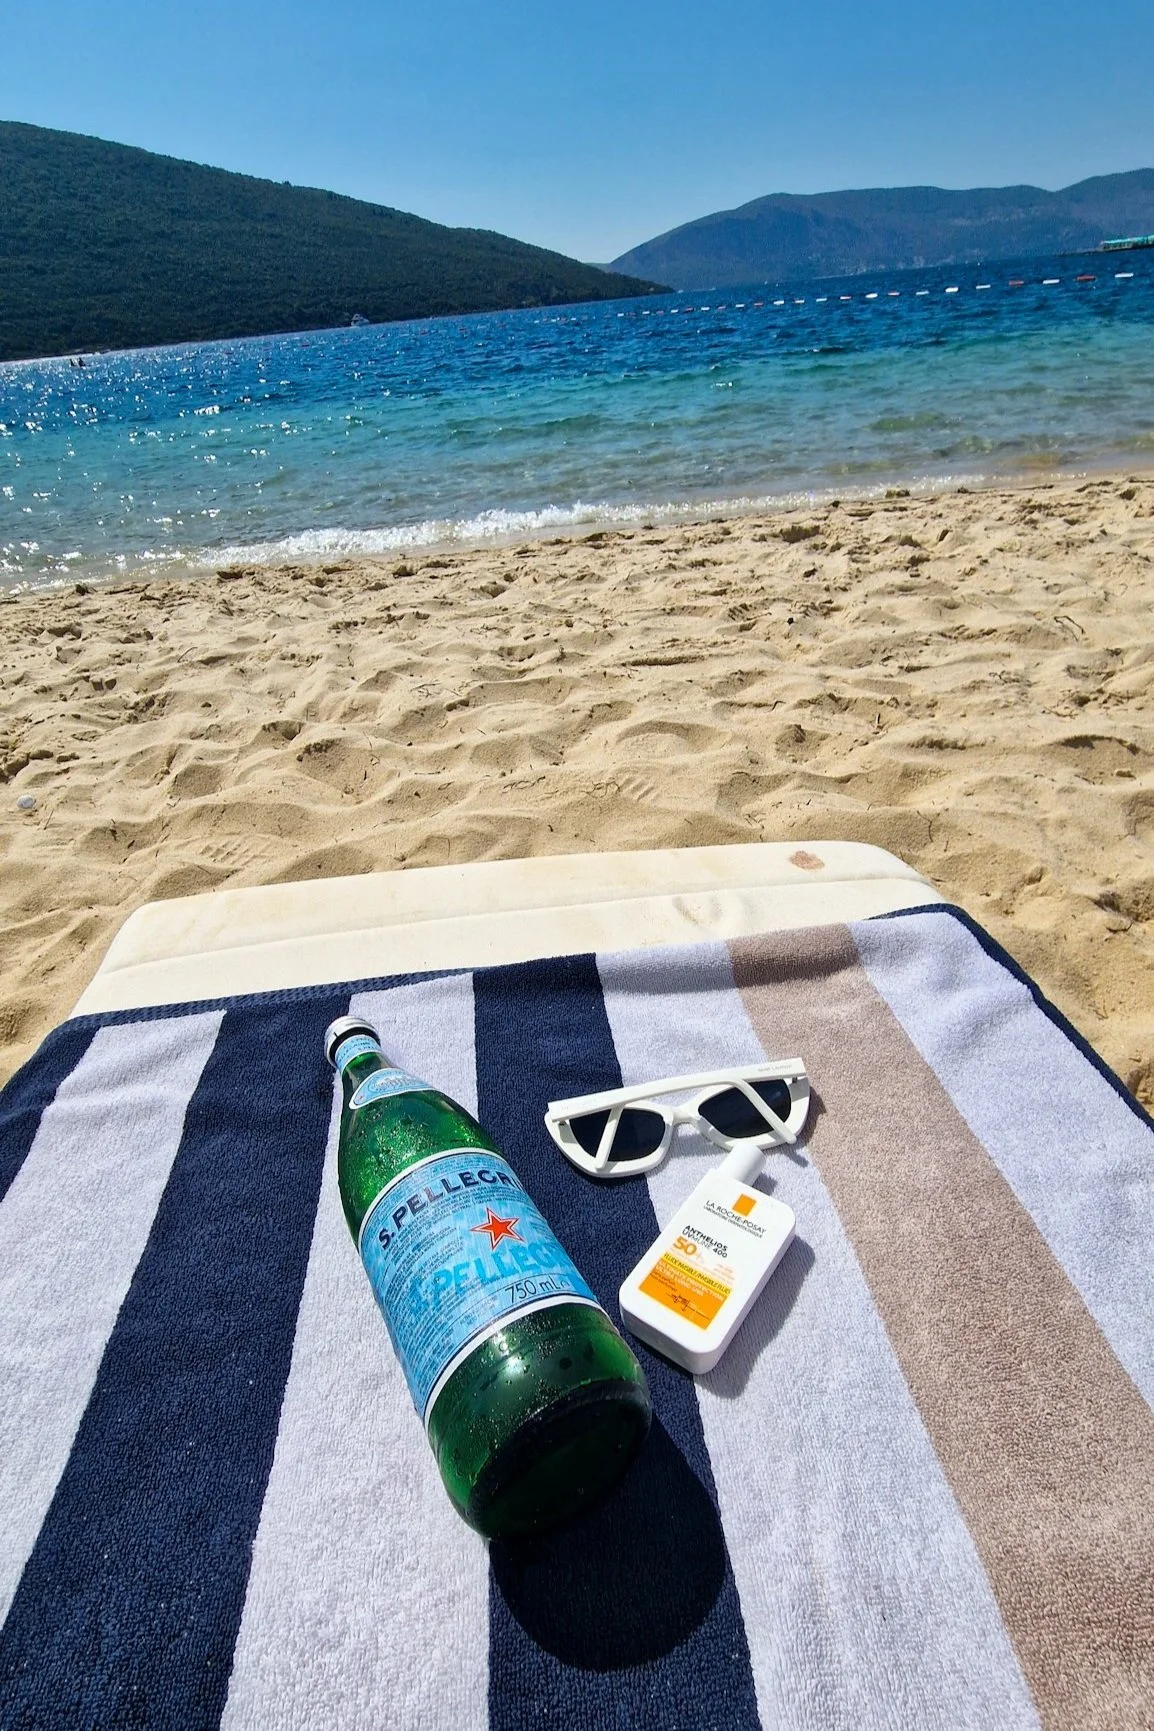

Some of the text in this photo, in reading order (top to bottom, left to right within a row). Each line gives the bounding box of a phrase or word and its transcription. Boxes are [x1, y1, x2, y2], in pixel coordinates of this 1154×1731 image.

[706, 1200, 767, 1234] LA ROCHE-POSAY
[685, 1225, 728, 1252] ANTHELIOS
[713, 1247, 728, 1259] 400
[505, 1280, 536, 1303] 750
